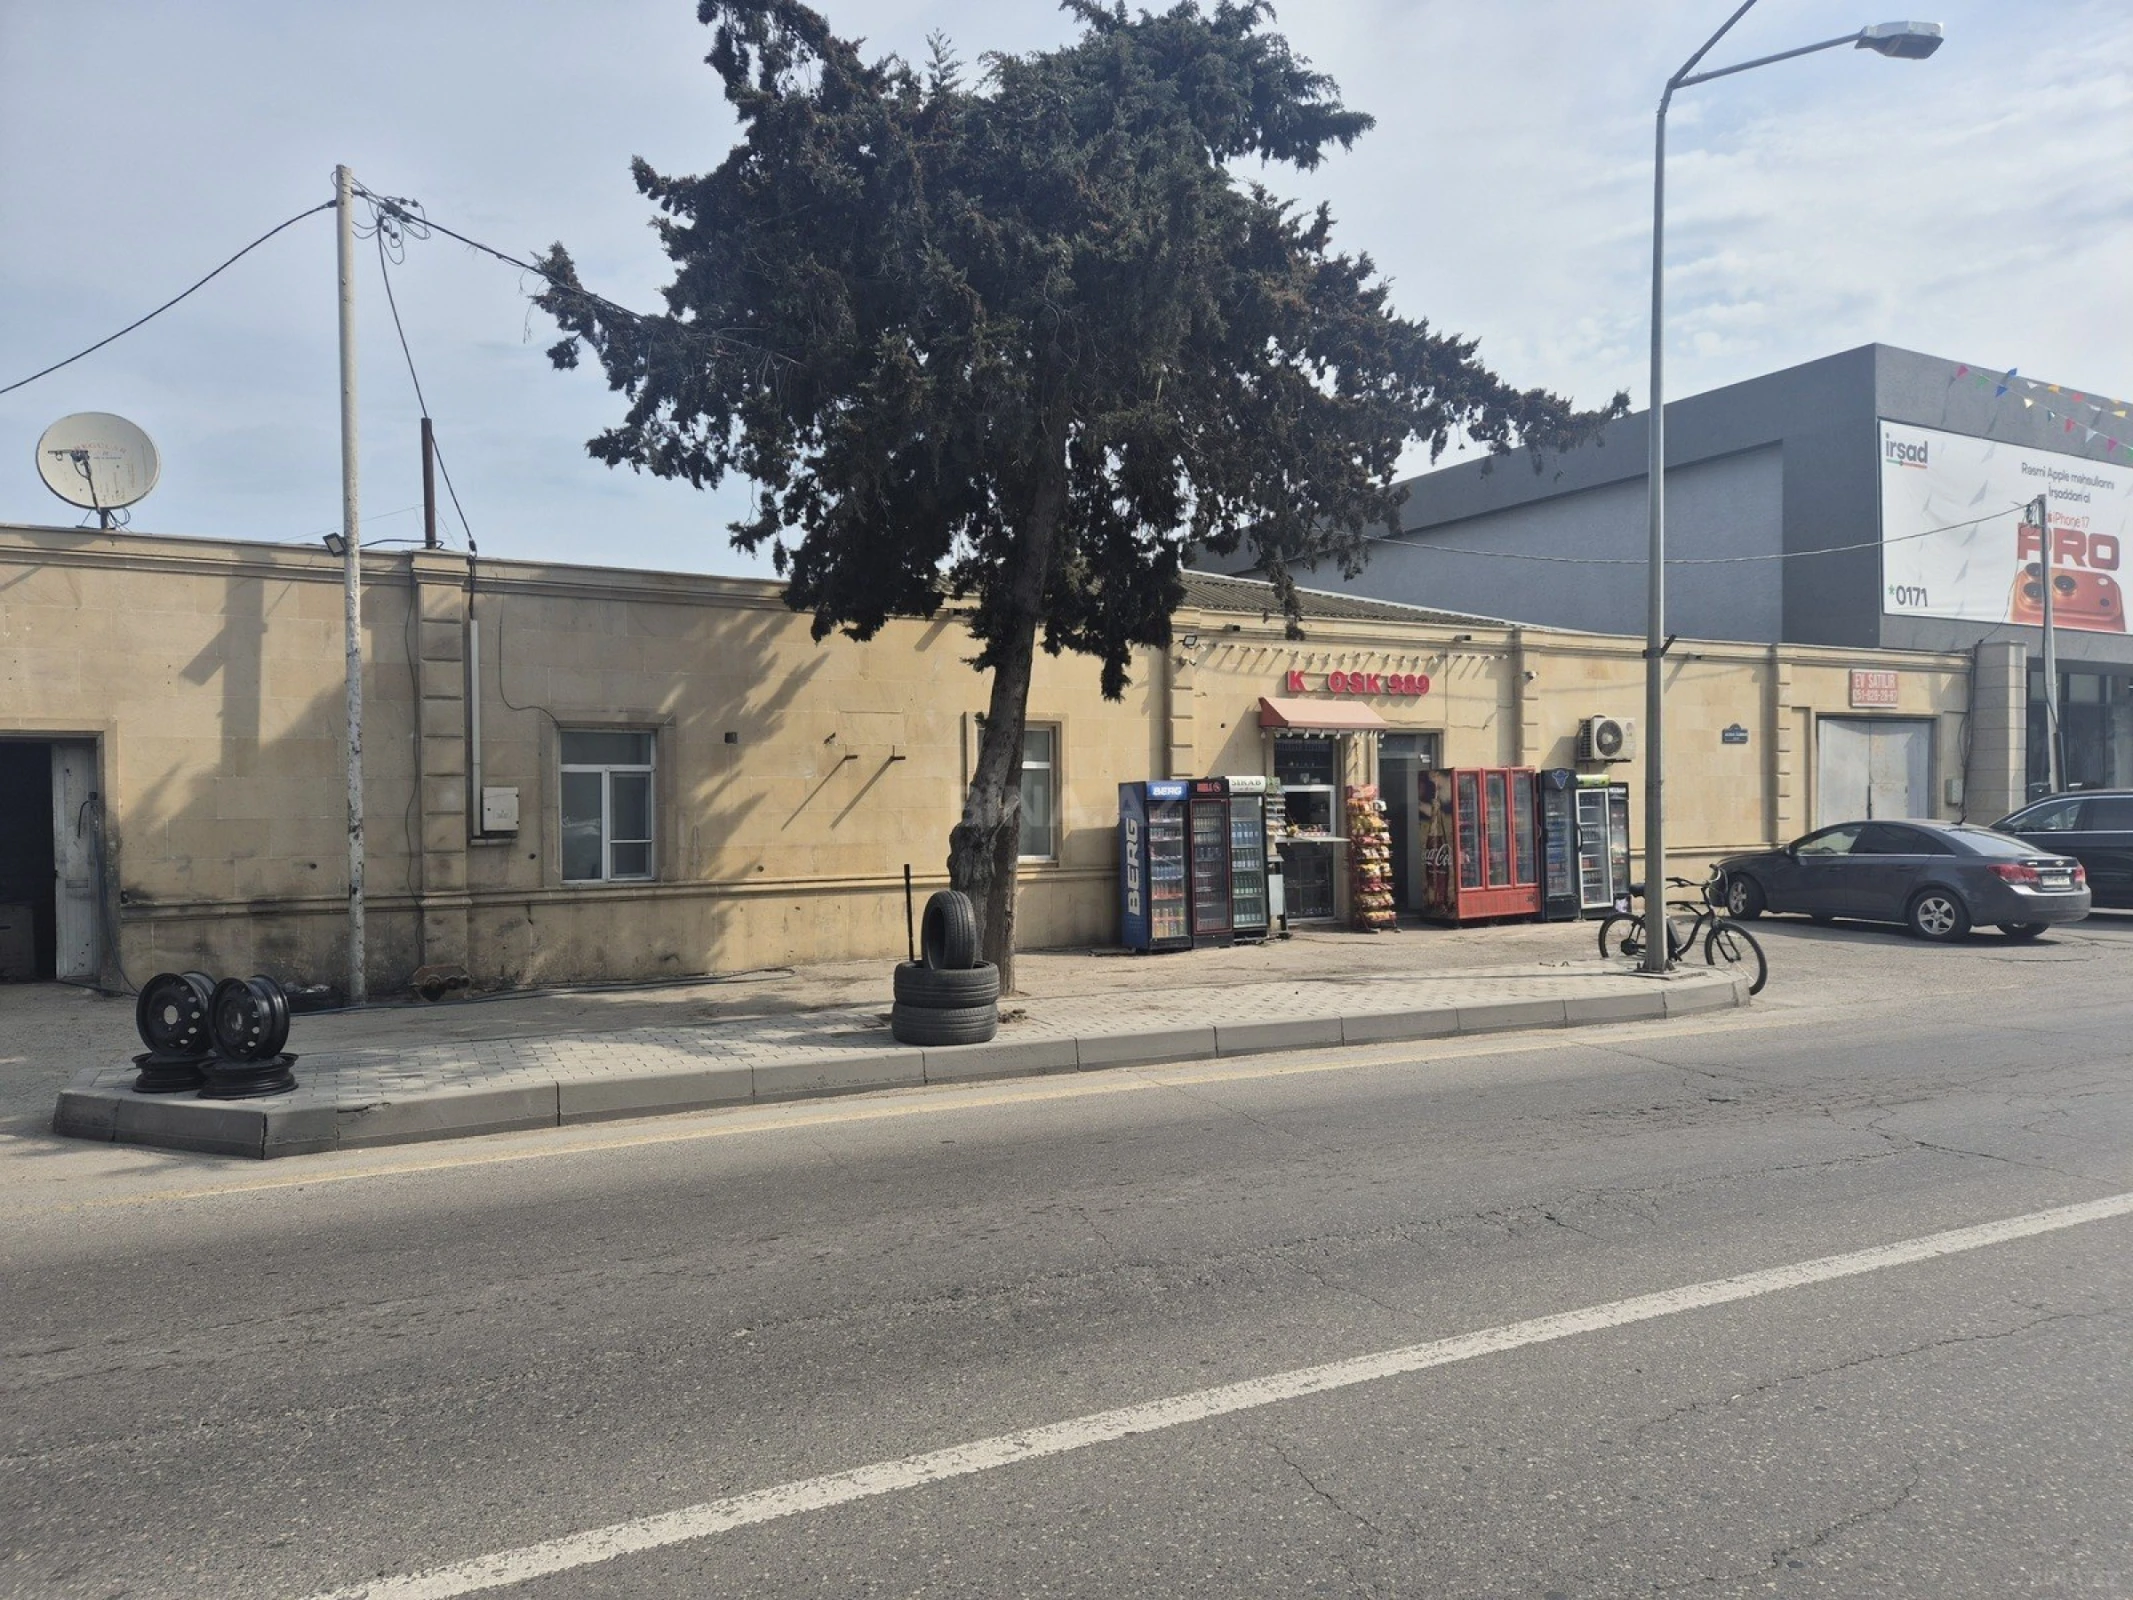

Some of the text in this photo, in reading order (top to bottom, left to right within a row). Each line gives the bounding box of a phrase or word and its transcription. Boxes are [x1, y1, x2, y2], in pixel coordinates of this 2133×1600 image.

[2047, 467, 2069, 482] Apple
[2017, 522, 2120, 571] PRO
[1153, 786, 1182, 796] BERG
[1125, 817, 1140, 916] BERG
